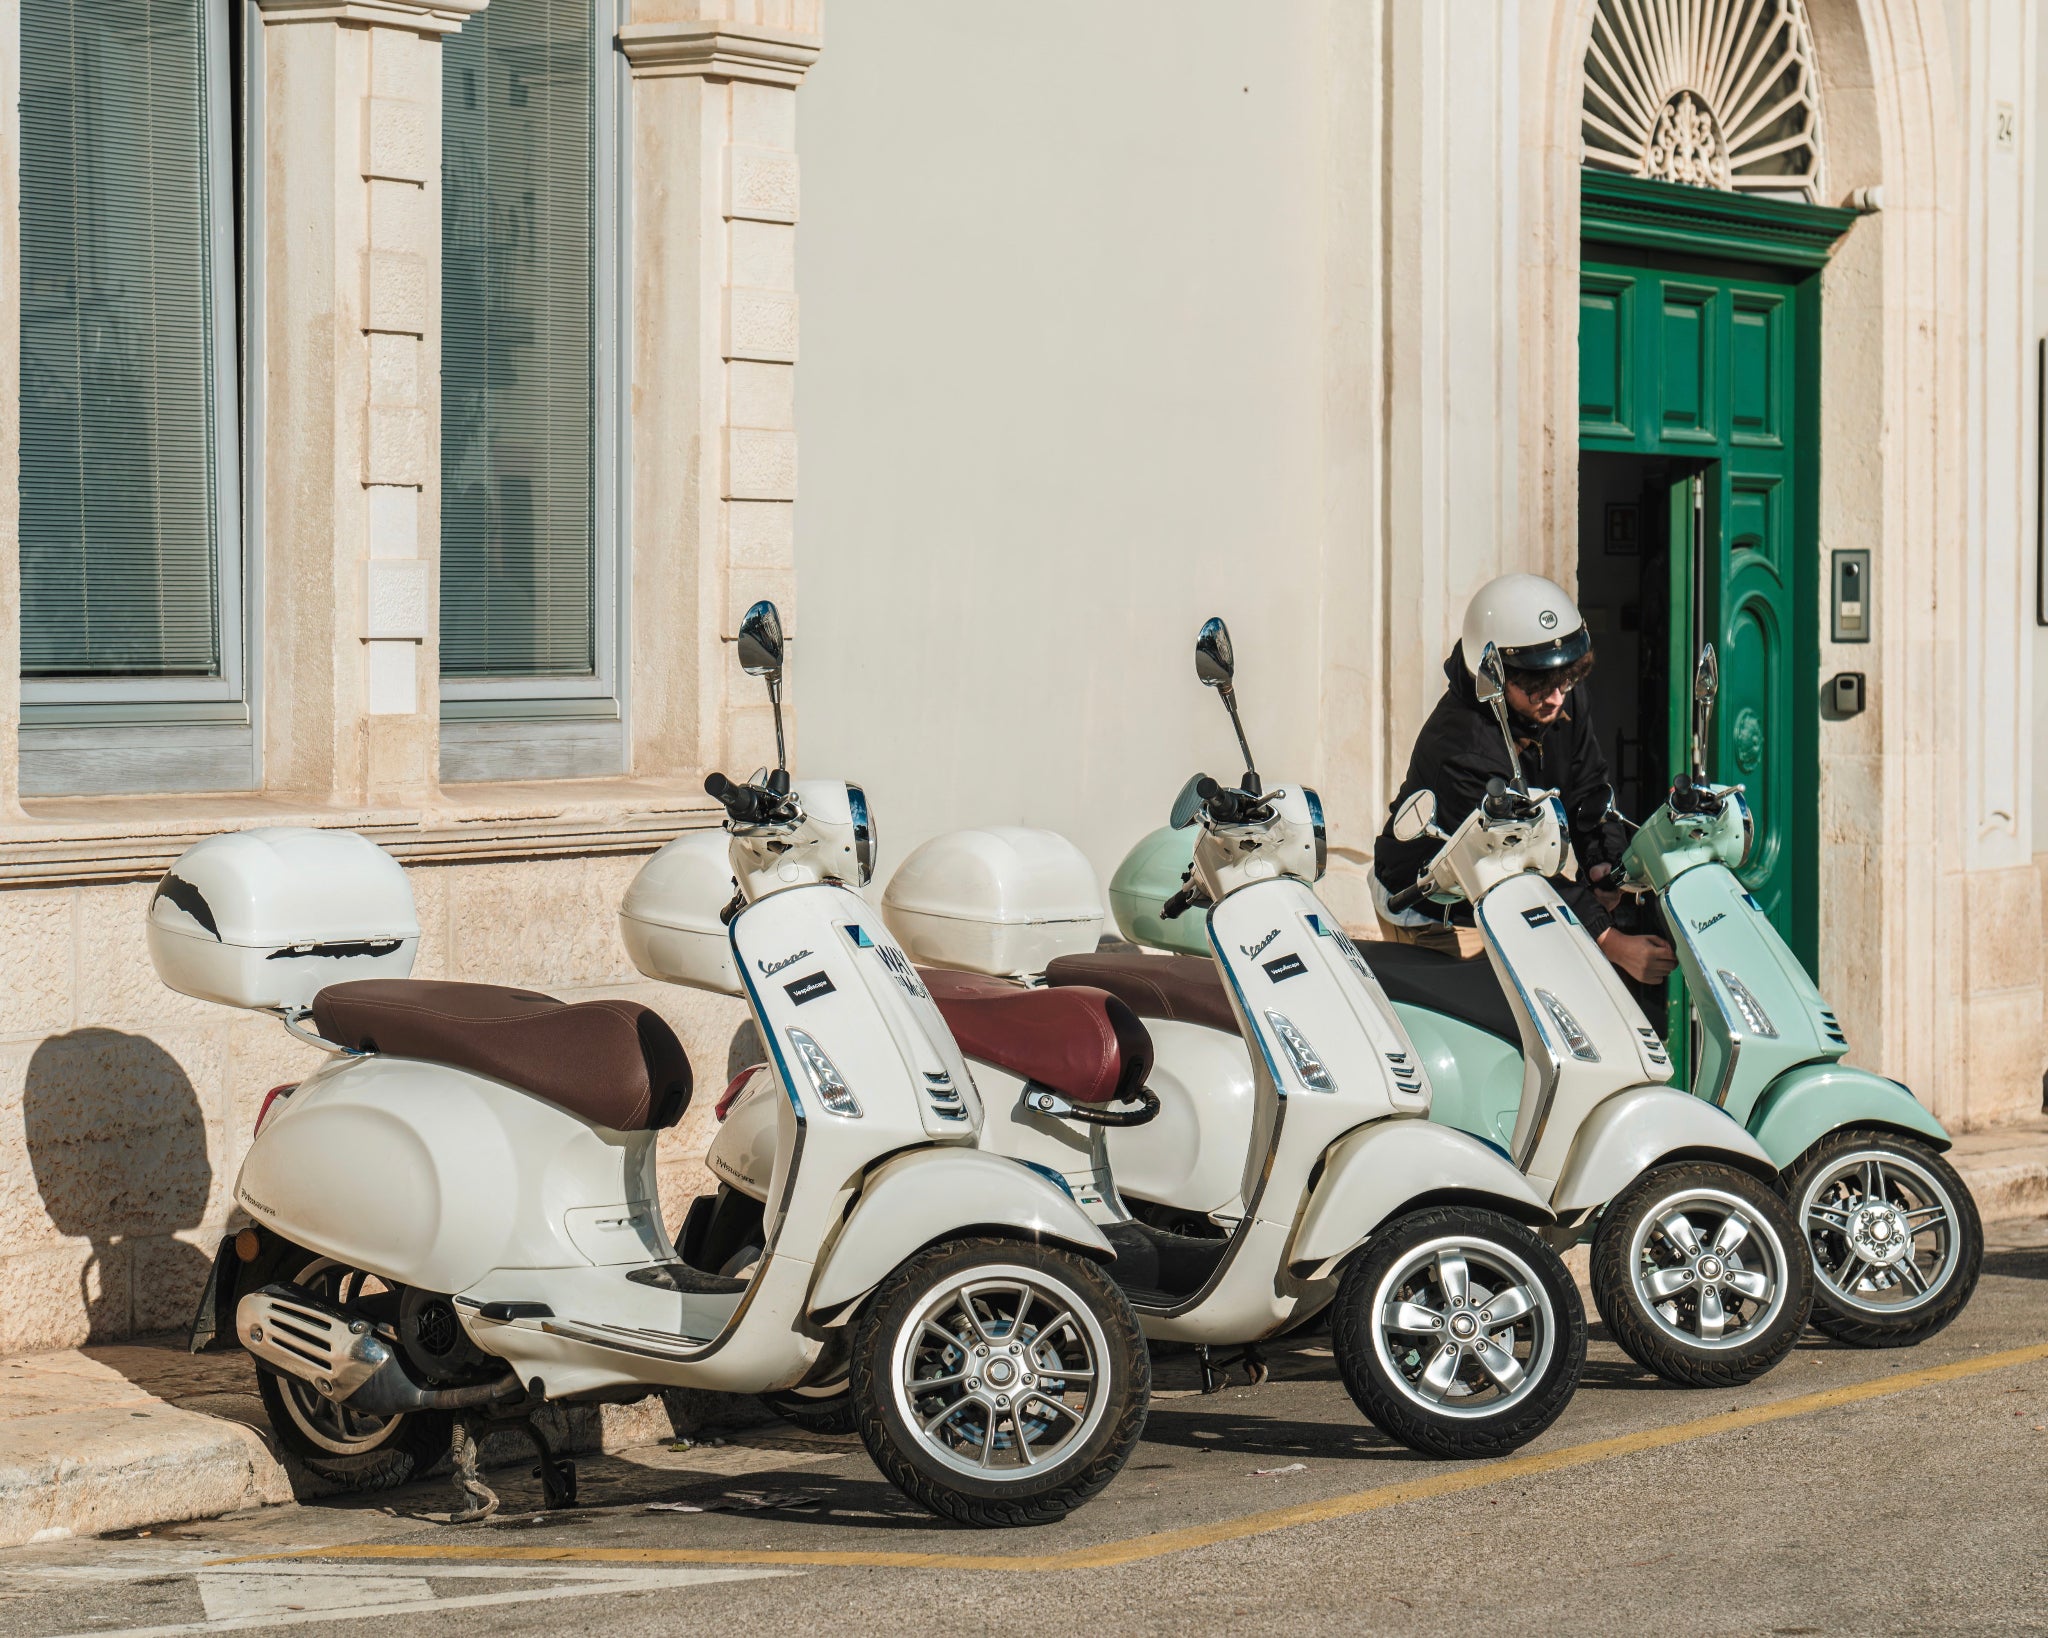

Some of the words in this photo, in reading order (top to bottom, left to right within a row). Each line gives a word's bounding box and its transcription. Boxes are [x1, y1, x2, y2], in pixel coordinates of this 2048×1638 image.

[1998, 112, 2012, 142] 24
[1690, 912, 1726, 934] Vespa
[1239, 928, 1281, 961] Vespa
[757, 949, 814, 978] Vespa
[875, 944, 914, 977] WAY
